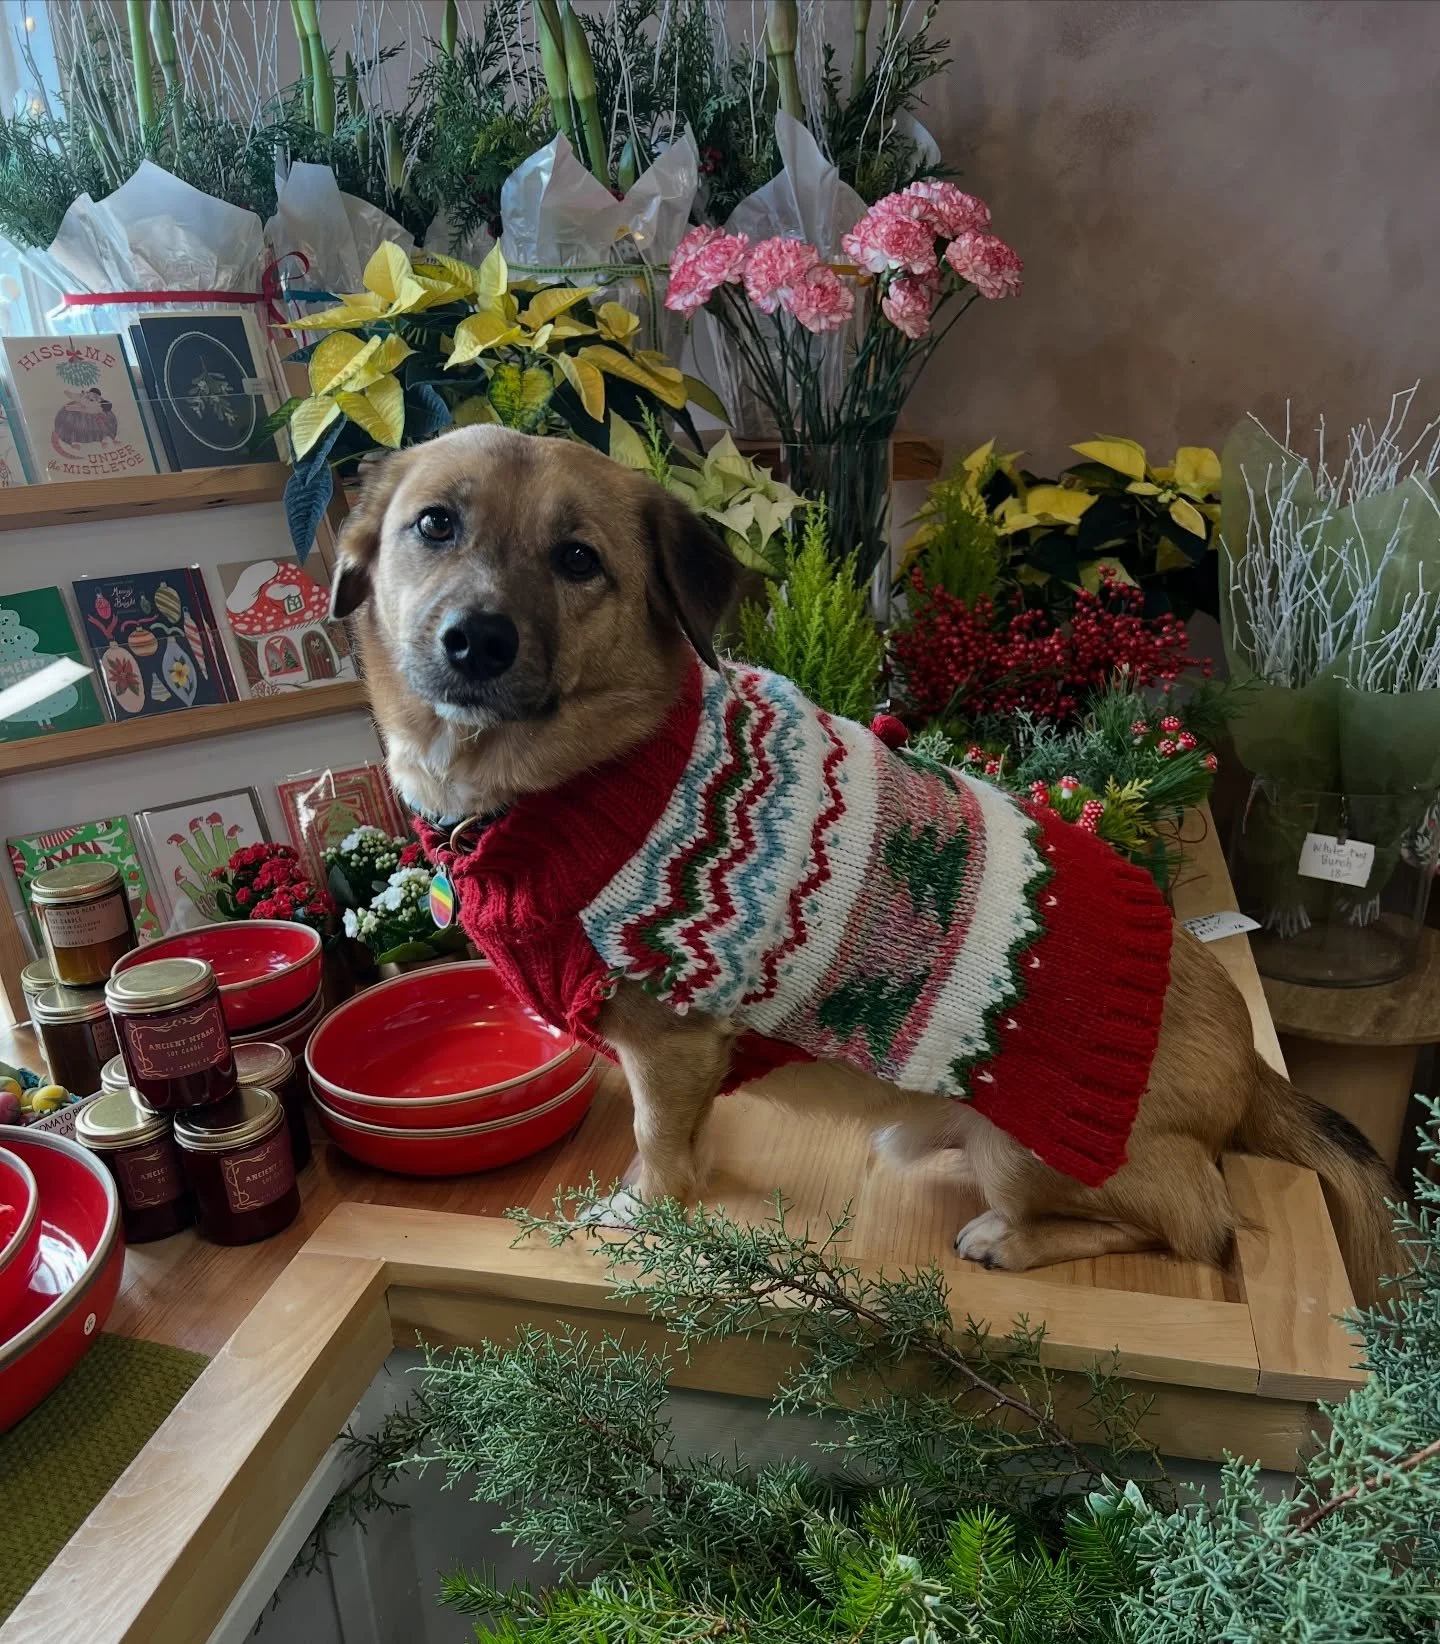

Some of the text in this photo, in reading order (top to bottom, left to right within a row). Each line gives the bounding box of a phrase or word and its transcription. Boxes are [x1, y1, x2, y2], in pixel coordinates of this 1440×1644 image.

[17, 344, 116, 371] HISS ME
[88, 444, 136, 464] UNDER
[64, 453, 144, 475] MISTLETOE
[1321, 854, 1352, 869] Bunch
[149, 1039, 186, 1050] ANCIENT
[181, 1042, 205, 1054] CANDLE
[36, 1112, 72, 1131] OMATO
